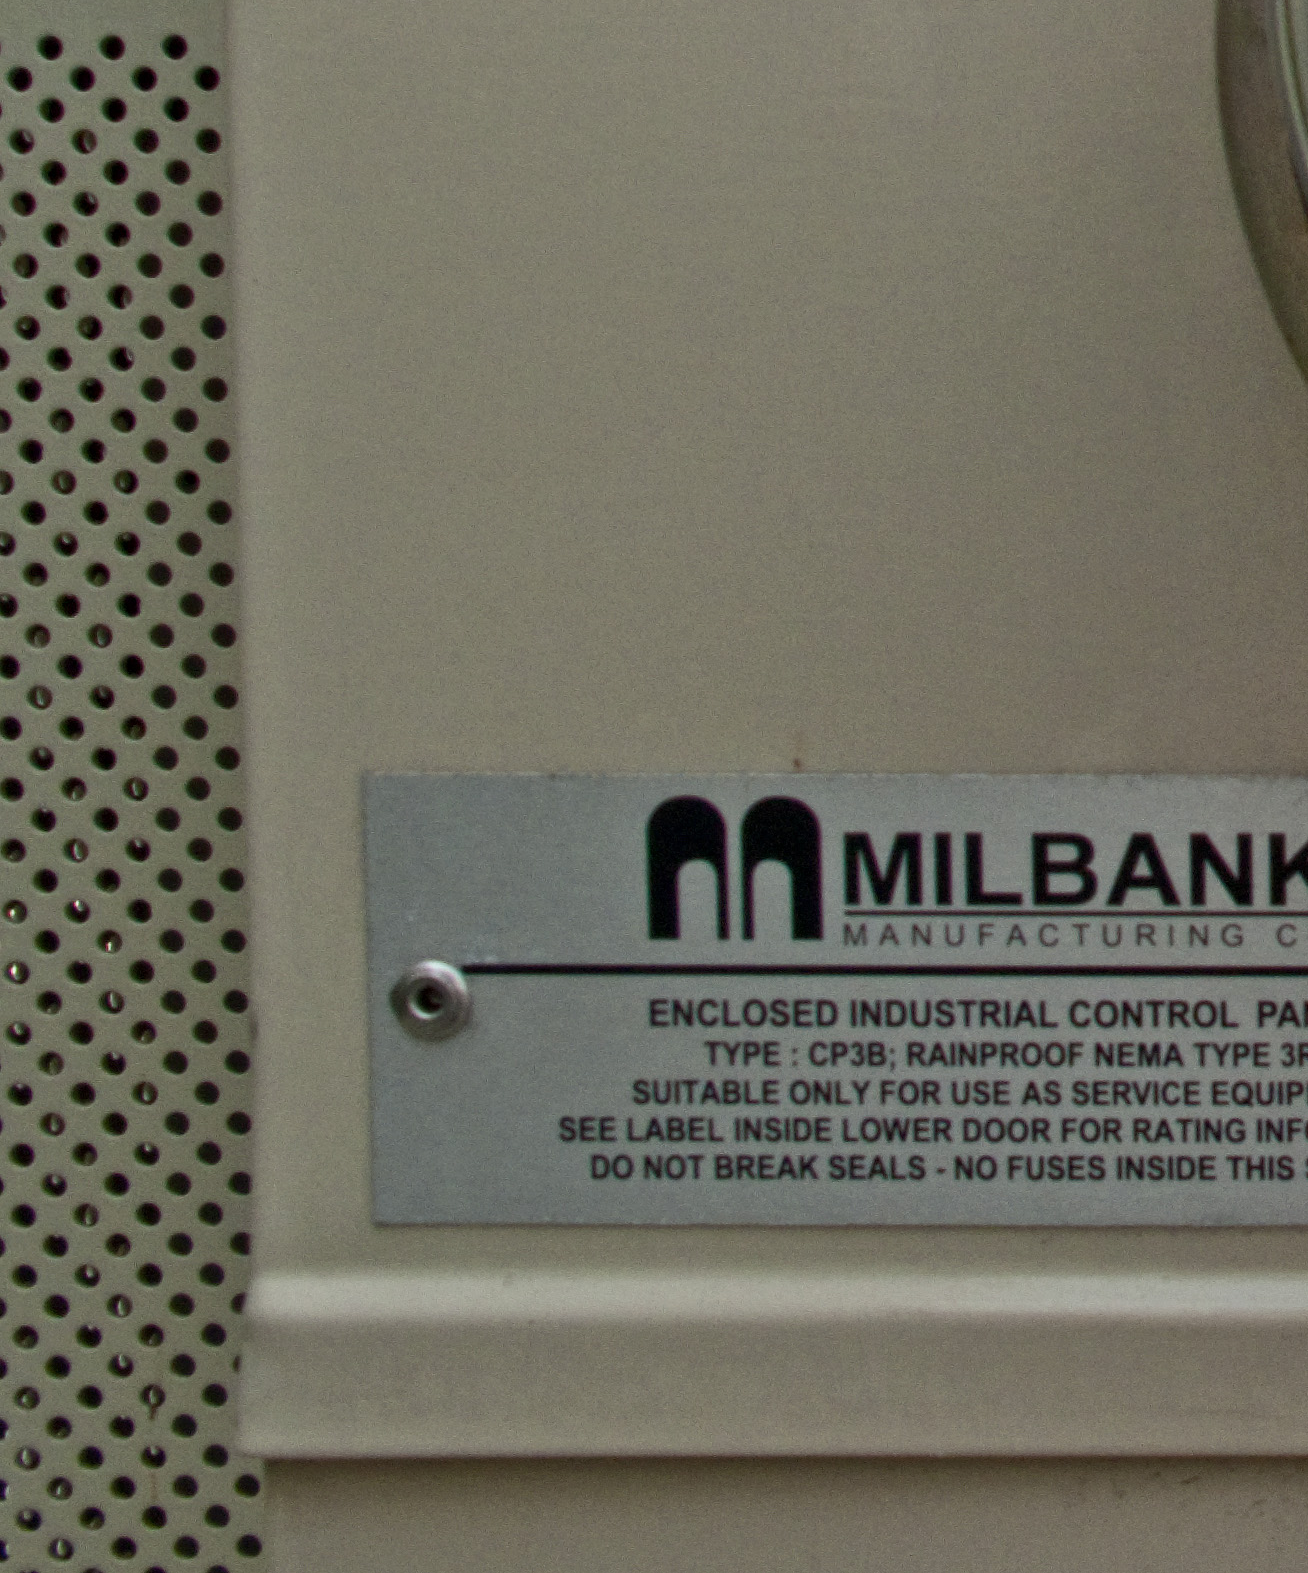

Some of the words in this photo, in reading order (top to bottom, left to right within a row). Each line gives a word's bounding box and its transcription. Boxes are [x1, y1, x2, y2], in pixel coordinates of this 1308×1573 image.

[843, 923, 1244, 948] MANUFACTURING
[649, 998, 839, 1028] ENCLOSED
[850, 998, 1058, 1028] INDUSTRIAL
[1068, 998, 1239, 1028] CONTROL
[704, 1041, 781, 1067] TYPE
[808, 1041, 896, 1071] CP3B;
[906, 1041, 1083, 1067] RAINPROOF
[1095, 1041, 1184, 1067] NEMA
[1194, 1041, 1271, 1067] TYPE
[632, 1079, 781, 1106] SUITABLE
[789, 1079, 871, 1106] ONLY
[879, 1079, 941, 1106] FOR
[951, 1079, 1010, 1106] USE
[1022, 1079, 1063, 1106] AS
[1072, 1079, 1200, 1106] SERVICE
[558, 1117, 617, 1144] SEE
[626, 1117, 724, 1144] LABEL
[733, 1117, 832, 1144] INSIDE
[841, 1117, 952, 1144] LOWER
[962, 1117, 1051, 1144] DOOR
[1061, 1117, 1122, 1144] FOR
[1132, 1117, 1246, 1144] RATING
[590, 1154, 634, 1181] DO
[642, 1154, 705, 1181] NOT
[714, 1154, 820, 1181] BREAK
[828, 1154, 927, 1181] SEALS
[953, 1154, 998, 1181] NO
[1007, 1154, 1106, 1181] FUSES
[1116, 1154, 1218, 1181] INSIDE
[1226, 1154, 1295, 1181] THIS
